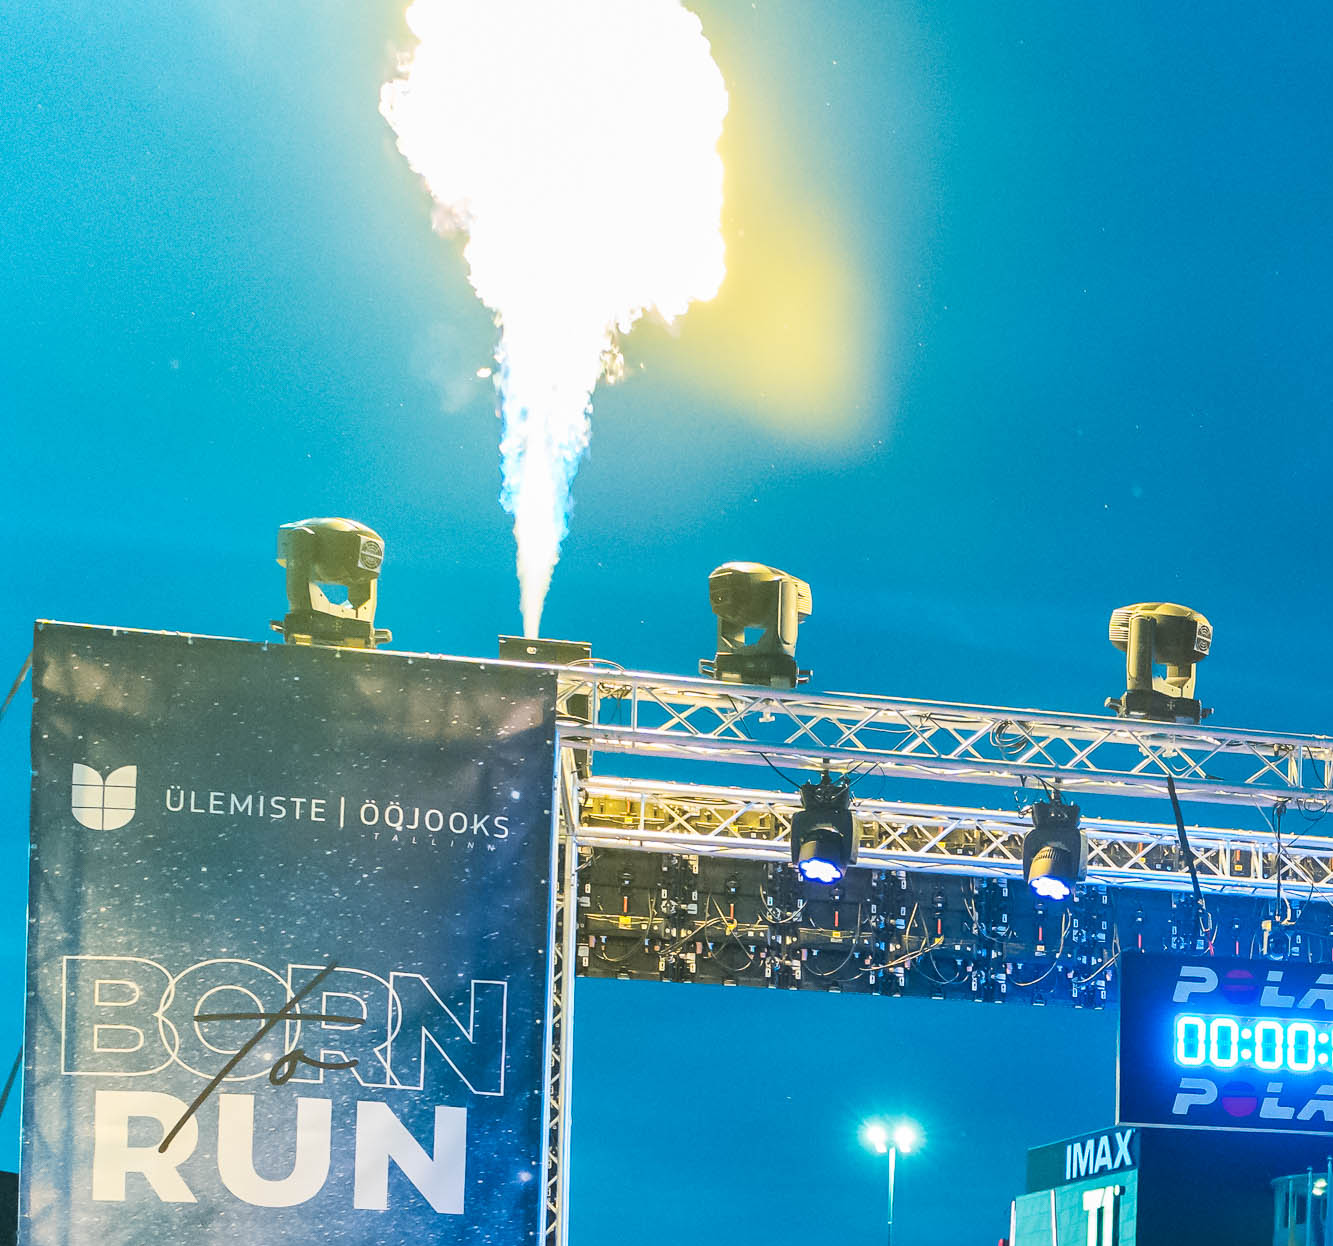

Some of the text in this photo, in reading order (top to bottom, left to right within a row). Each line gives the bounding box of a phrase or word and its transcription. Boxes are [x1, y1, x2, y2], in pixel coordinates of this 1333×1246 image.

[166, 784, 510, 839] ÜLEMISTE ÖÖJOOKS
[372, 832, 497, 852] TALLINN
[61, 955, 508, 1096] BORN
[92, 1089, 468, 1215] RUN
[1066, 1129, 1132, 1180] IMAX
